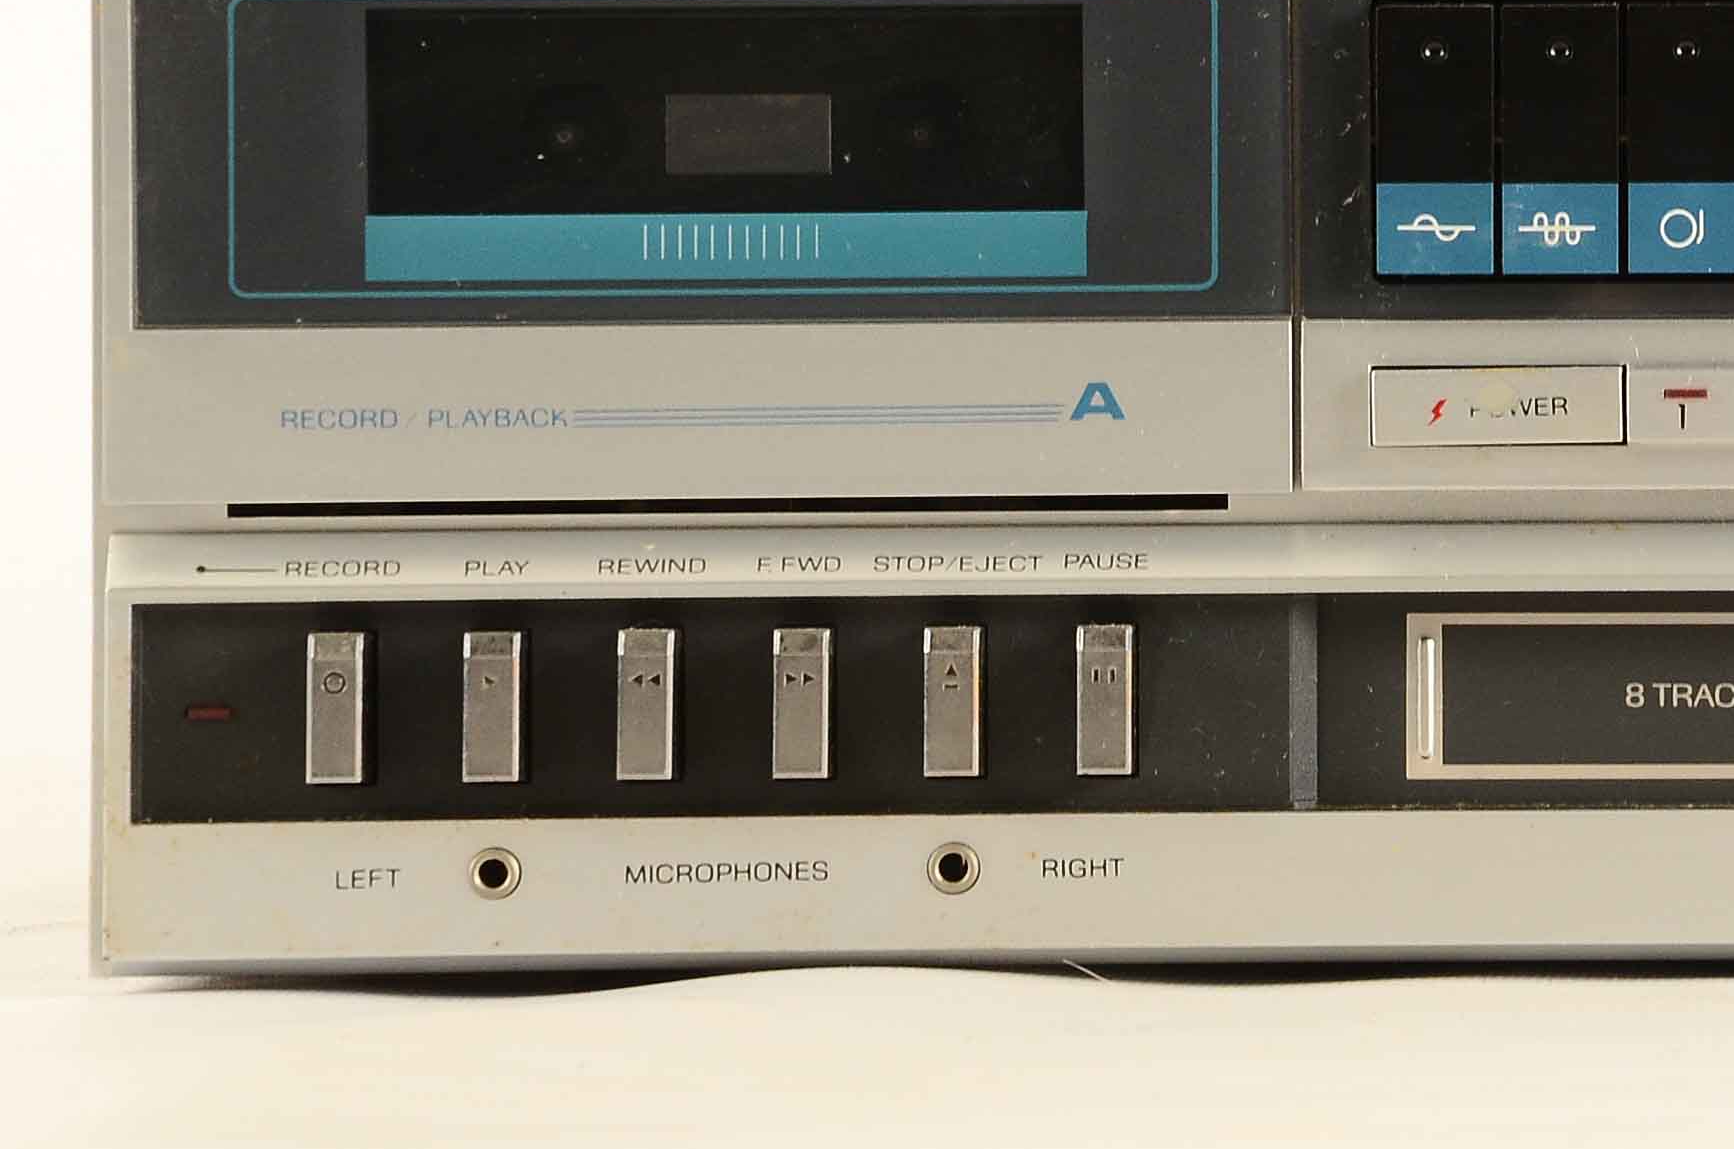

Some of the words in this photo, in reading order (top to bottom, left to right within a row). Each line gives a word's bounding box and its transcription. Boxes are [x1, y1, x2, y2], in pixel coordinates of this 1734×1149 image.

[1069, 382, 1125, 421] A
[1470, 396, 1568, 418] WER
[281, 408, 401, 430] RECORD
[428, 408, 568, 429] PLAYBACK
[1678, 403, 1688, 430] 1
[285, 559, 401, 577] RECORD
[464, 559, 529, 576] PLAY
[598, 557, 706, 574] REWIND
[873, 555, 1043, 572] STOP/EJECT
[1064, 552, 1148, 569] PAUSE
[1625, 682, 1645, 708] 8
[625, 861, 829, 884] MICROPHONES
[1042, 857, 1124, 878] RIGHT
[335, 868, 400, 890] LEFT
